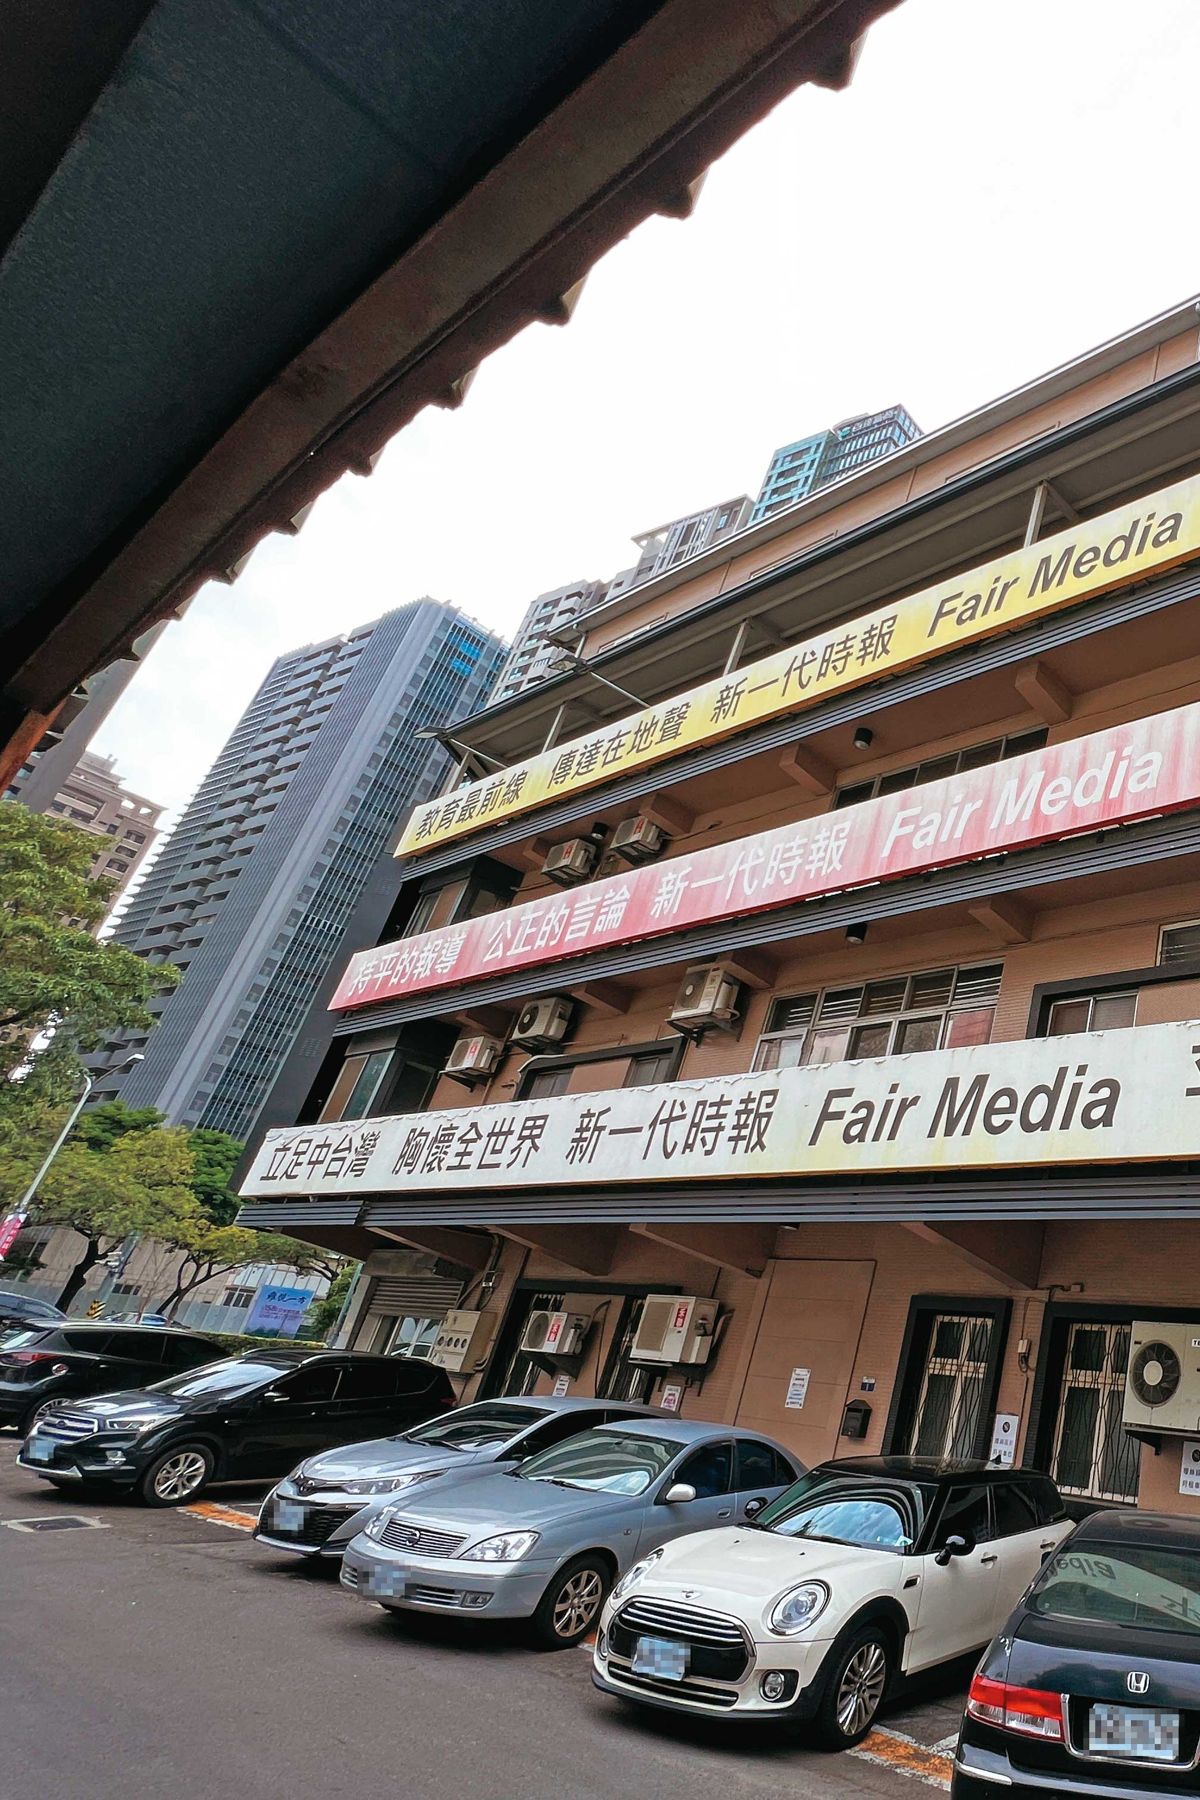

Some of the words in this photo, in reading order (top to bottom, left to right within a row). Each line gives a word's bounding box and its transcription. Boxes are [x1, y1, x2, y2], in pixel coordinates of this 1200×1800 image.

[415, 770, 528, 841] 教育最前線
[547, 702, 693, 790] 傳達在地聲
[710, 613, 898, 723] 新一代時報
[927, 573, 1020, 638] Fair
[1028, 511, 1183, 598] Media
[347, 935, 463, 998] 持平的報導
[482, 887, 633, 967] 公正的言論
[649, 821, 853, 918] 新一代時報
[882, 800, 982, 857] Fair
[990, 746, 1164, 830] Media
[260, 1132, 380, 1181] 立足中台灣
[392, 1114, 550, 1175] 胸懷全世界
[566, 1088, 779, 1165] 新一代時報
[807, 1082, 921, 1147] Fair
[927, 1064, 1121, 1138] Media
